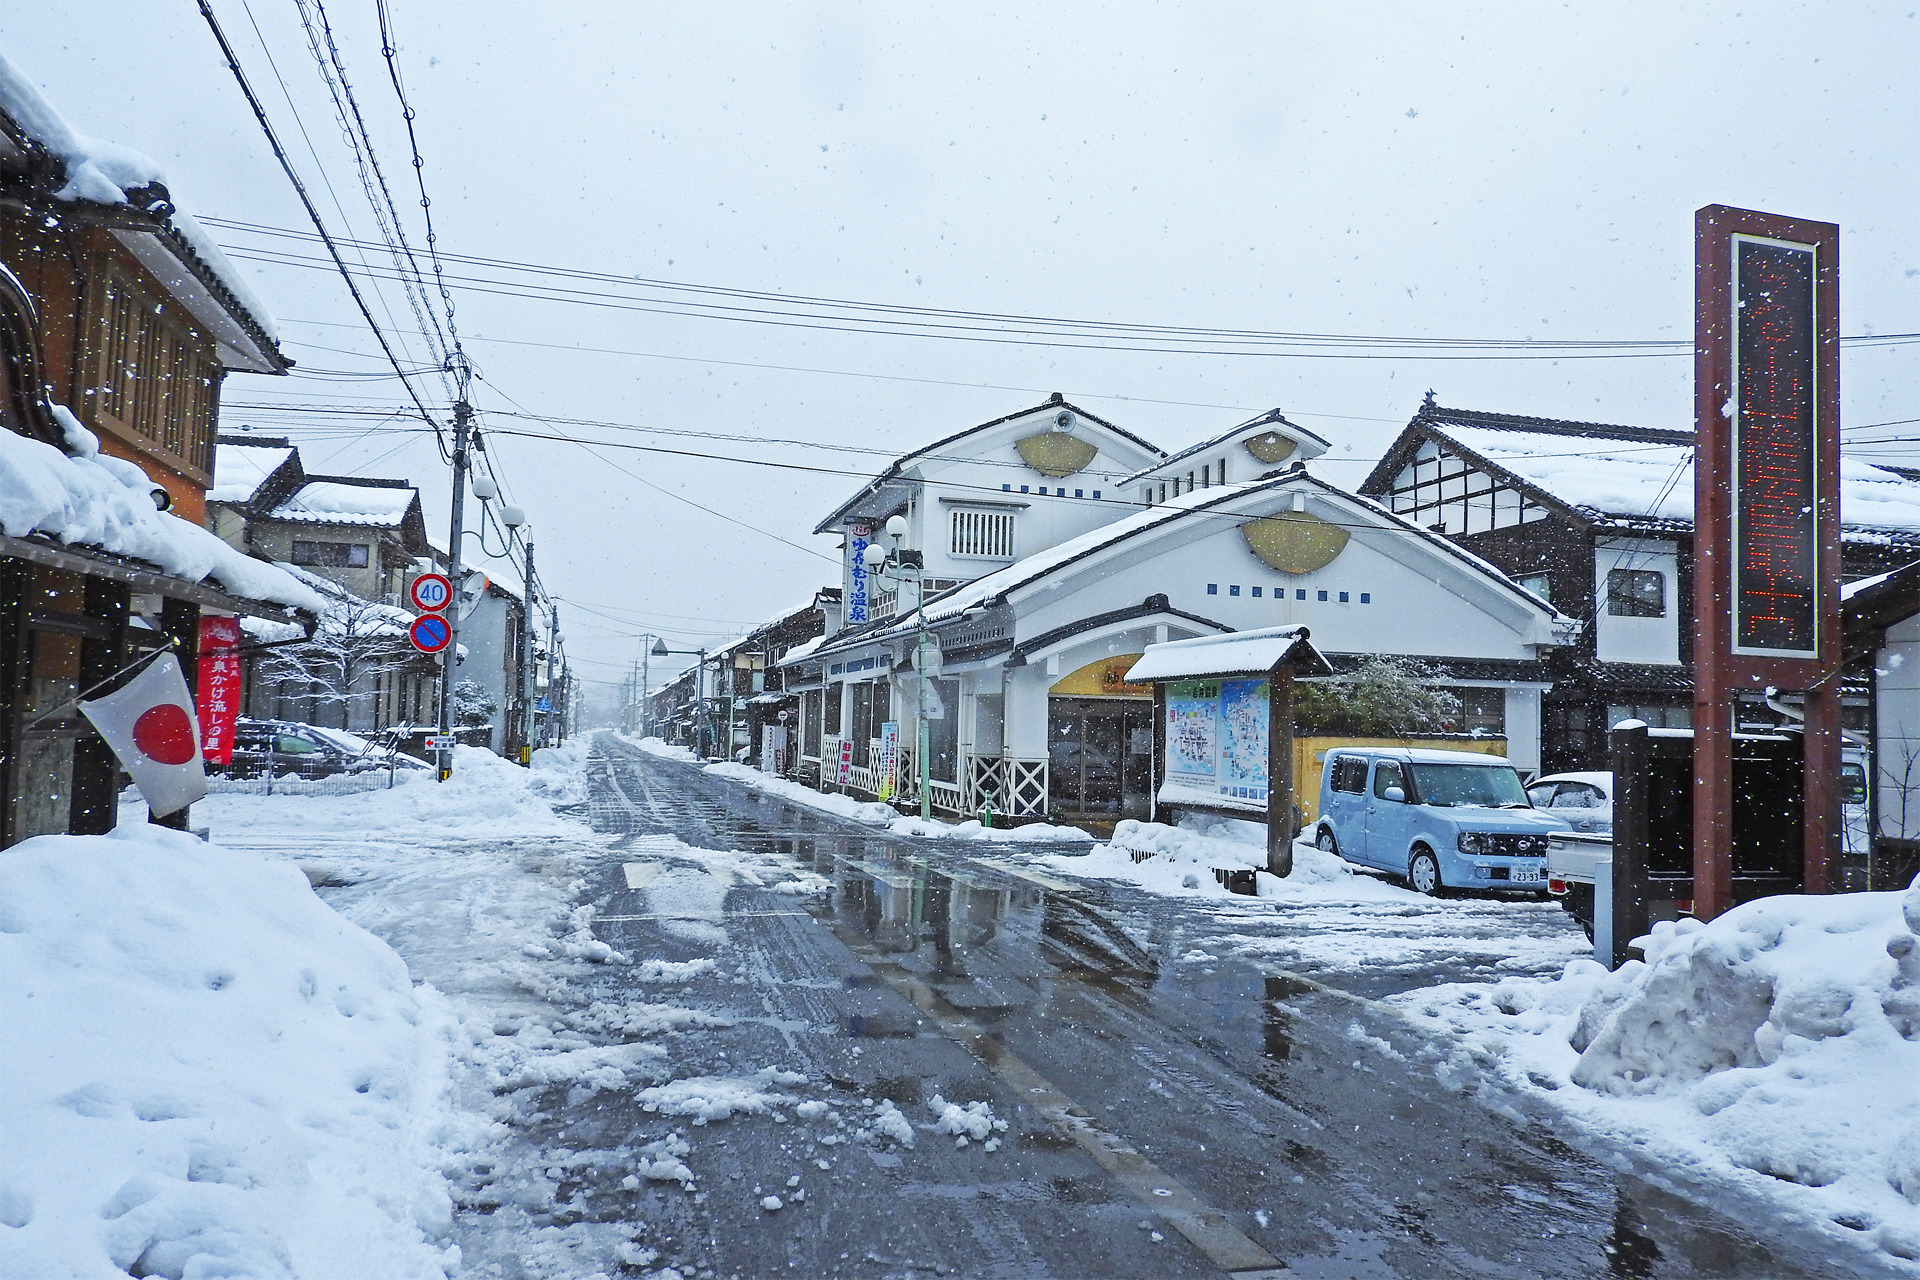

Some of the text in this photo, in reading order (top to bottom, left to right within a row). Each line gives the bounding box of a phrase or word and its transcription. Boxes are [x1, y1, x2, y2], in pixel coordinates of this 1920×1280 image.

[420, 584, 443, 601] 40
[850, 537, 868, 622] ゆかむり温泉
[839, 742, 852, 784] 駐車禁止
[1517, 872, 1539, 882] 23-93
